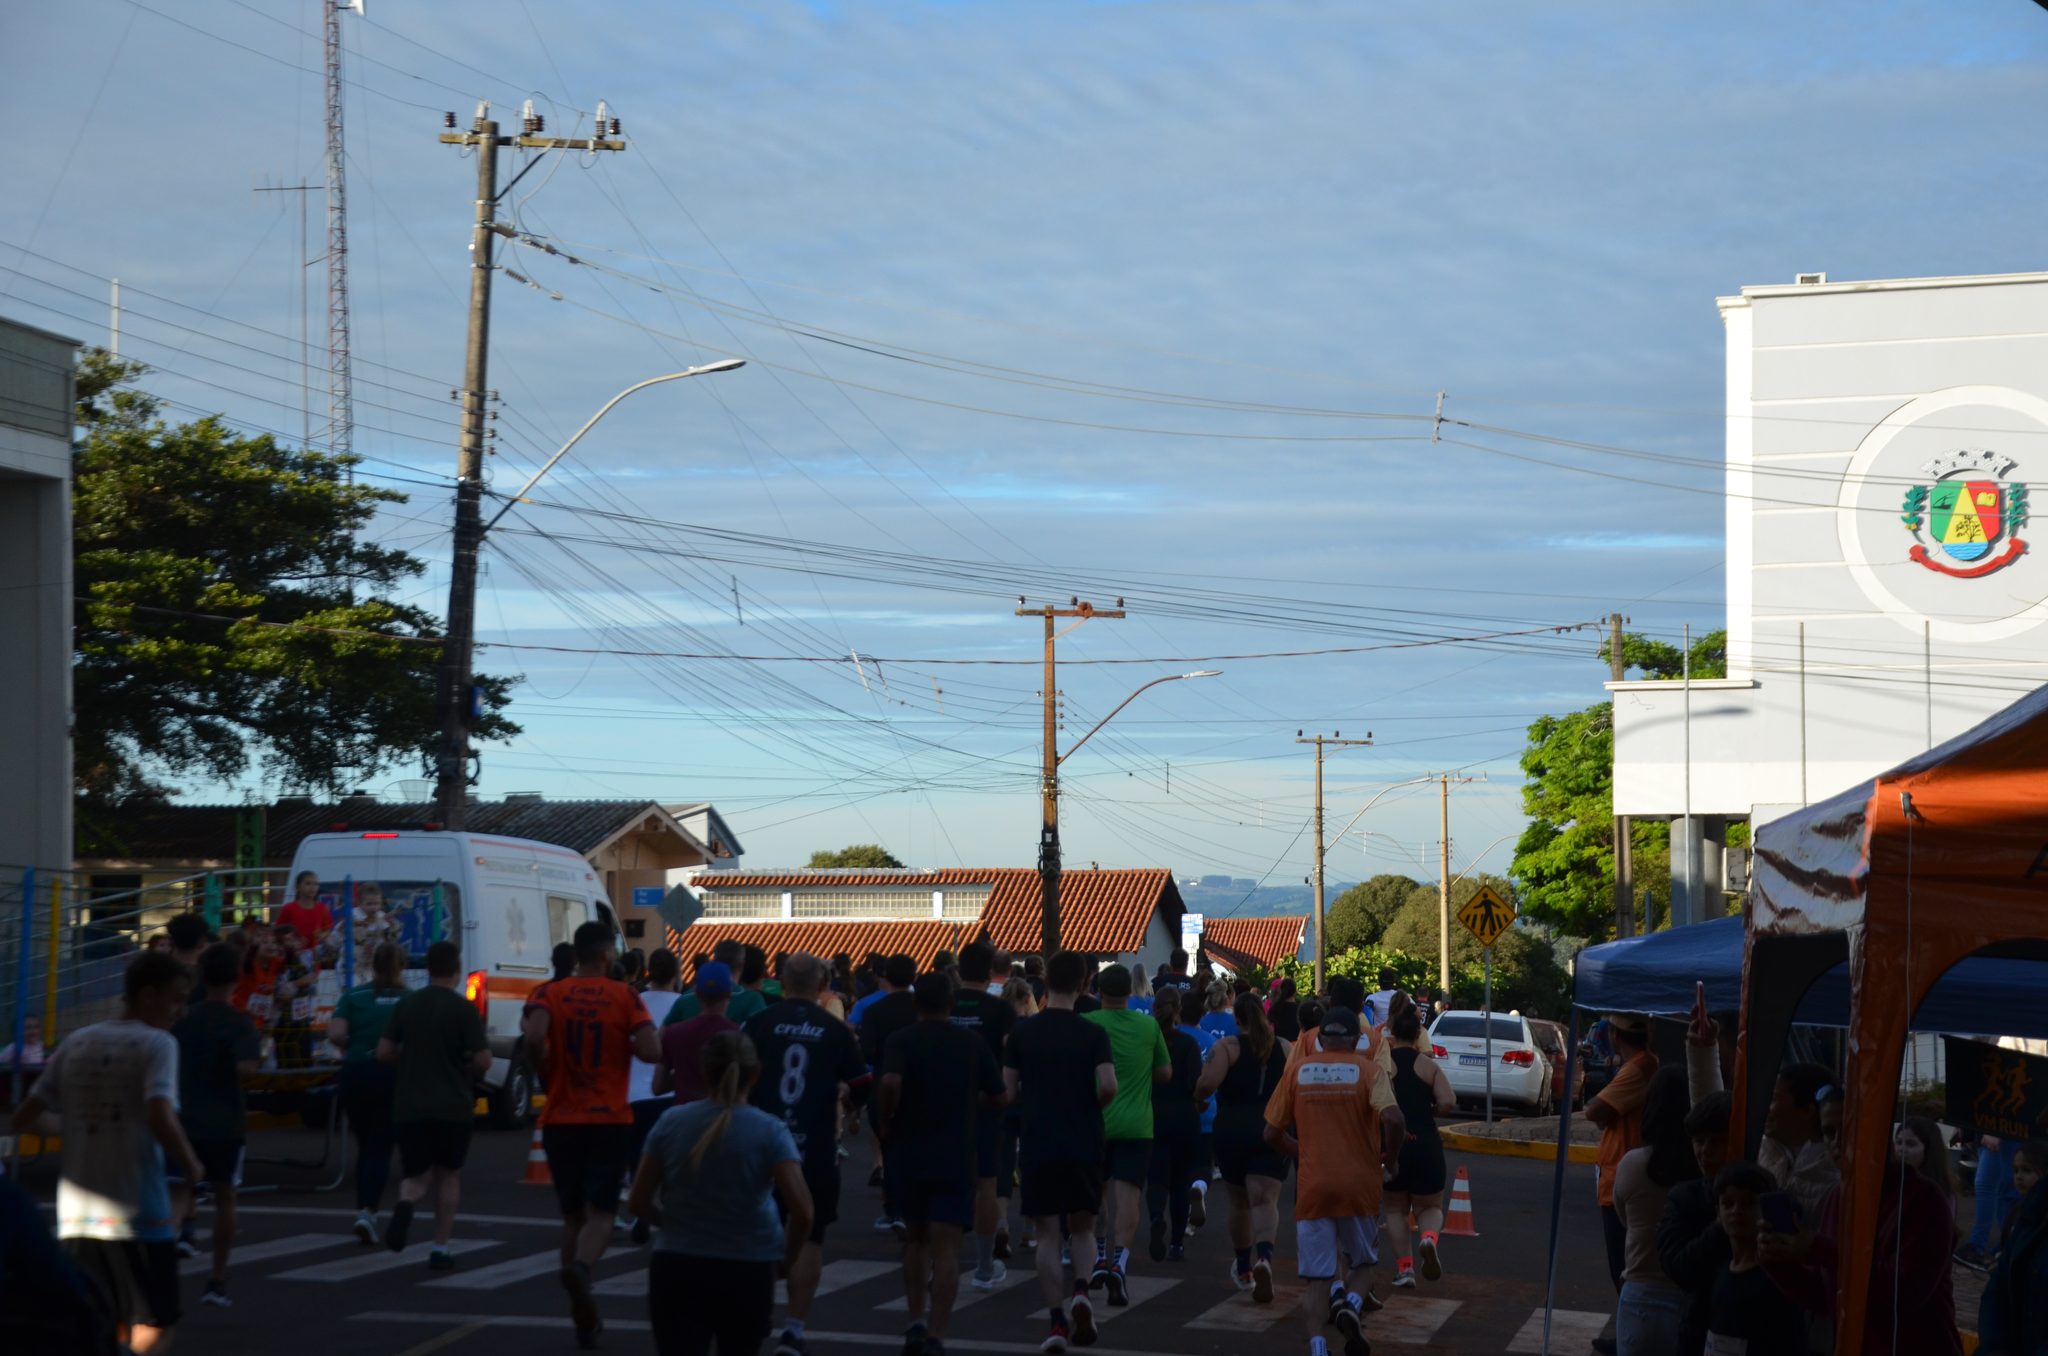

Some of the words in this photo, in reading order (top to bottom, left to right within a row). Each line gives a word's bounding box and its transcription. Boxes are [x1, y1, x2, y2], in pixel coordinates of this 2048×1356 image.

[565, 1019, 603, 1068] 41
[773, 1021, 826, 1038] creluz
[779, 1042, 809, 1104] 8
[1999, 1118, 2030, 1139] RUN
